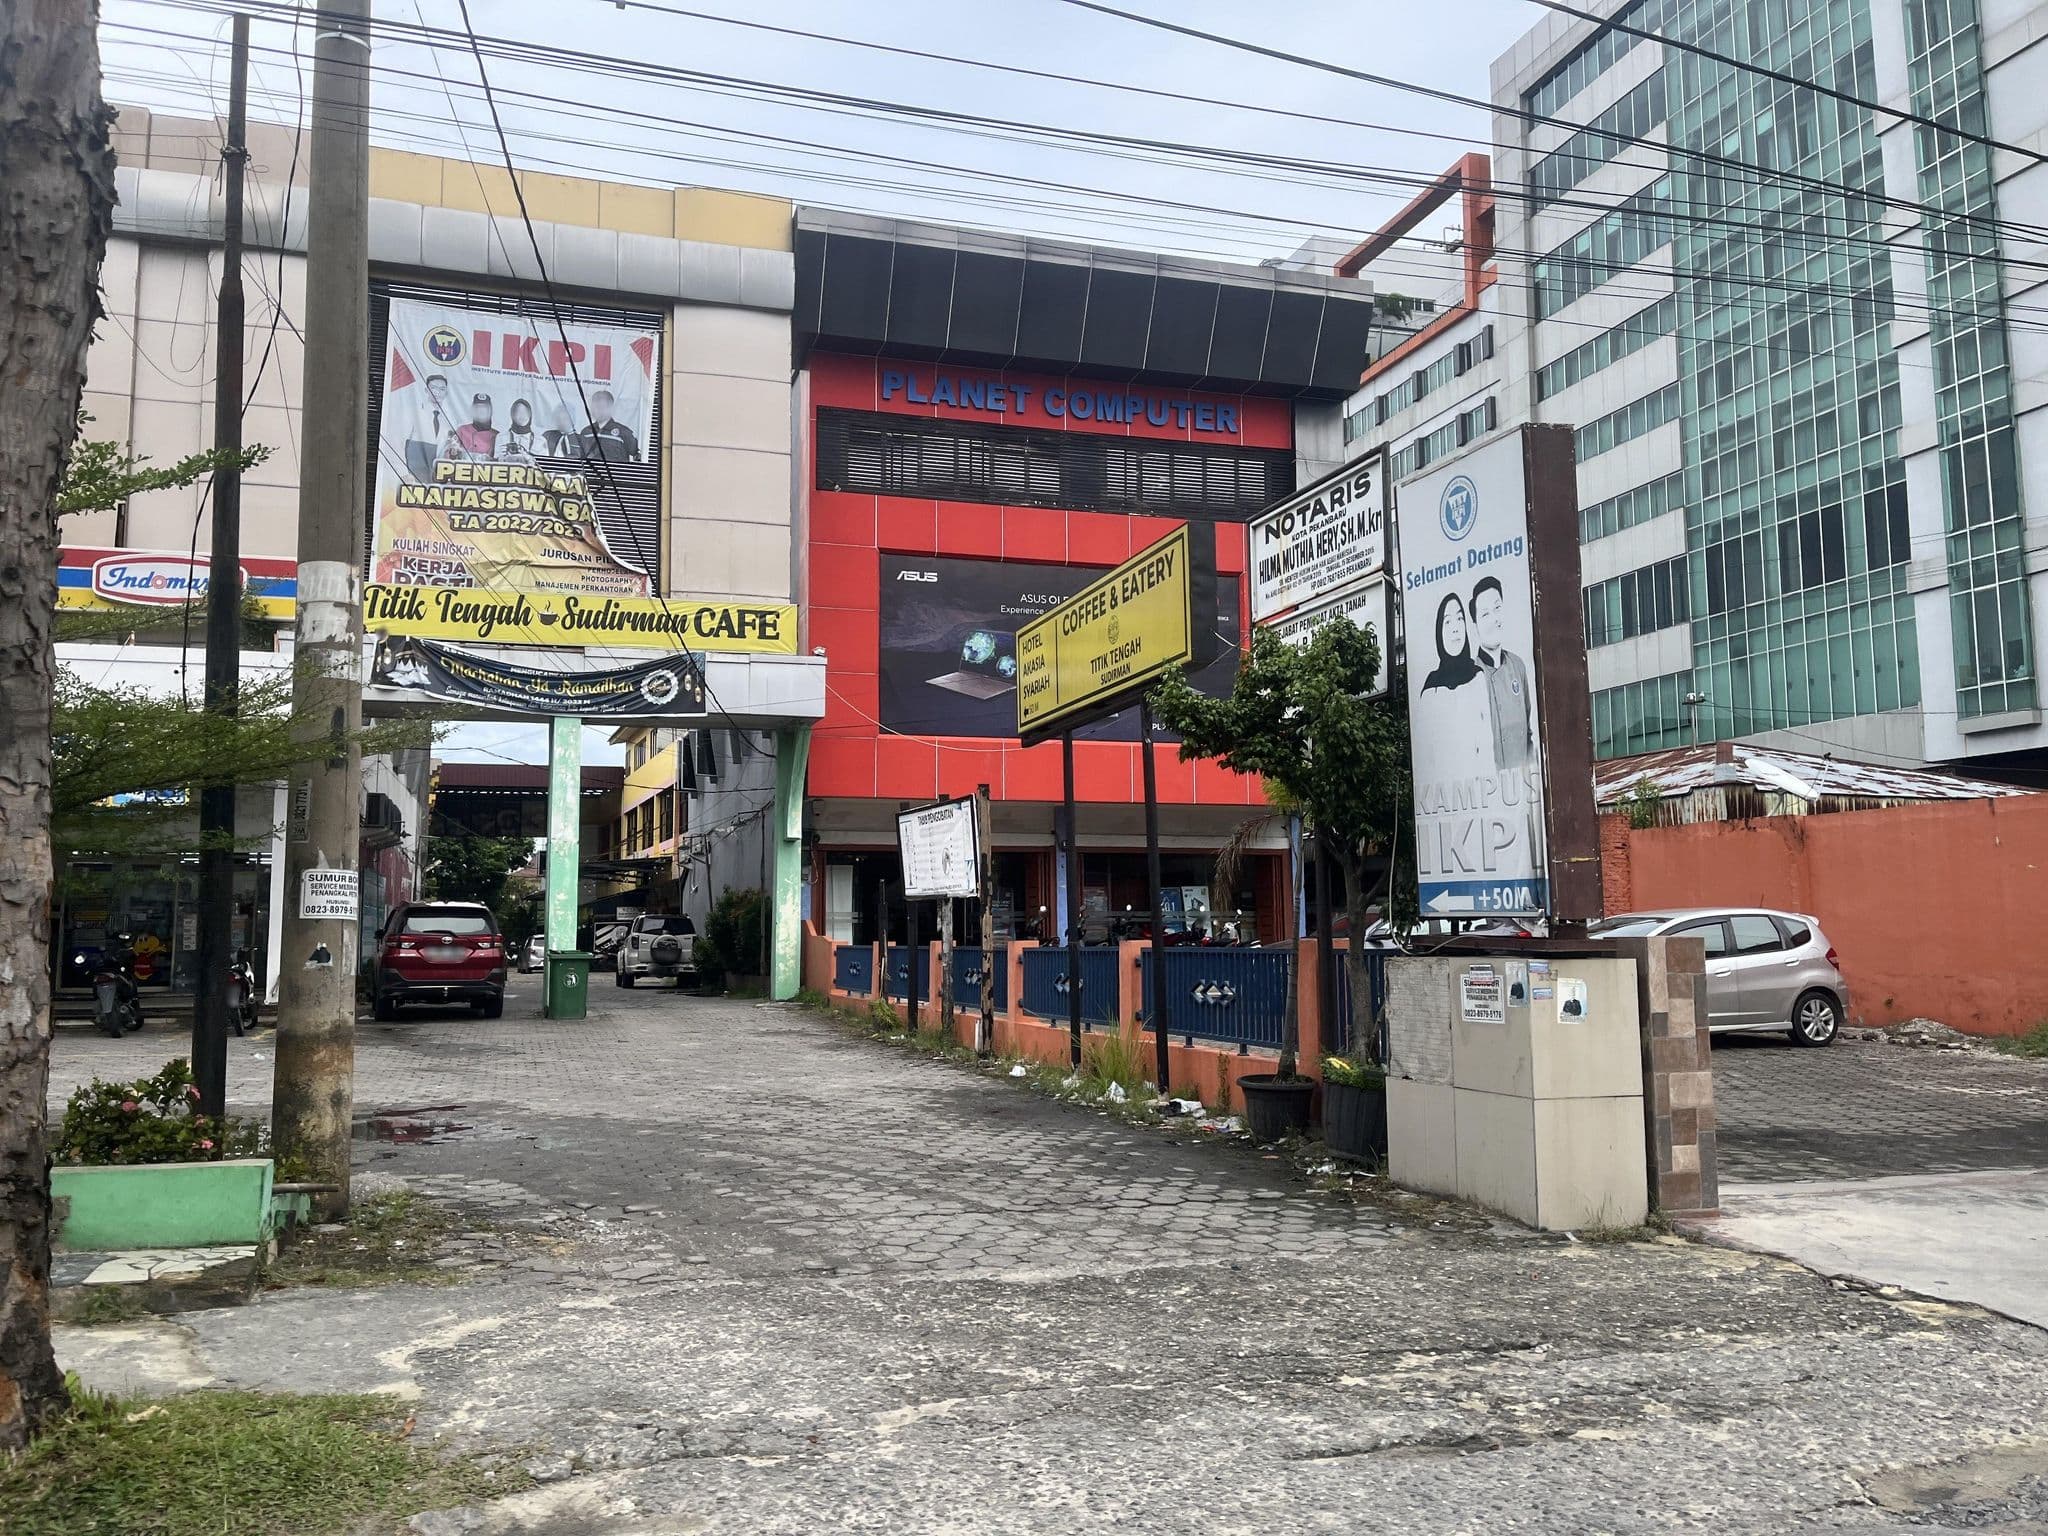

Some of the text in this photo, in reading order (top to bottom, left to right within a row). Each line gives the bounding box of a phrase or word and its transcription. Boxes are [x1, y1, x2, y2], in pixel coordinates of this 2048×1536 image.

[471, 329, 612, 381] IKPI
[882, 370, 1239, 434] PLANET COMPUTER
[400, 485, 592, 522] MAHASISWA BA
[1265, 472, 1371, 544] NOTARIS
[452, 516, 479, 529] T.A
[1292, 508, 1347, 542] KOTA PEKANBARU
[392, 538, 475, 556] KULIAH SINGKAT
[540, 548, 615, 565] JURUSAN PIL
[402, 557, 466, 575] KERJA
[1260, 553, 1282, 586] HILMA
[1283, 537, 1315, 574] MUTHIA
[1406, 535, 1523, 591] Selamat Datang
[103, 566, 210, 590] Indomar
[534, 581, 579, 590] MANAJEMEN
[581, 575, 634, 585] PHOTOGRAPHY
[897, 571, 938, 582] ASUS
[1020, 593, 1047, 605] ASUS
[1062, 549, 1176, 636] COFFEE & EATERY
[364, 584, 780, 640] Titik Tengah Sudirman CAFE
[1001, 605, 1045, 616] Experience
[1329, 604, 1344, 621] AKTA
[1345, 594, 1366, 615] TANAH
[1022, 632, 1043, 656] HOTEL
[1090, 636, 1142, 675] TITIK TENGAH
[1023, 653, 1046, 678] AKASIA
[1101, 662, 1131, 686] SUDIRMAN
[525, 678, 550, 695] Ya
[554, 678, 634, 697] Ramadhan
[1023, 674, 1050, 700] SYARIAH
[1415, 768, 1541, 815] KAMPUS
[1417, 813, 1544, 875] IKPI
[308, 873, 357, 885] SUMUR BO
[311, 889, 348, 897] PENANGKAL
